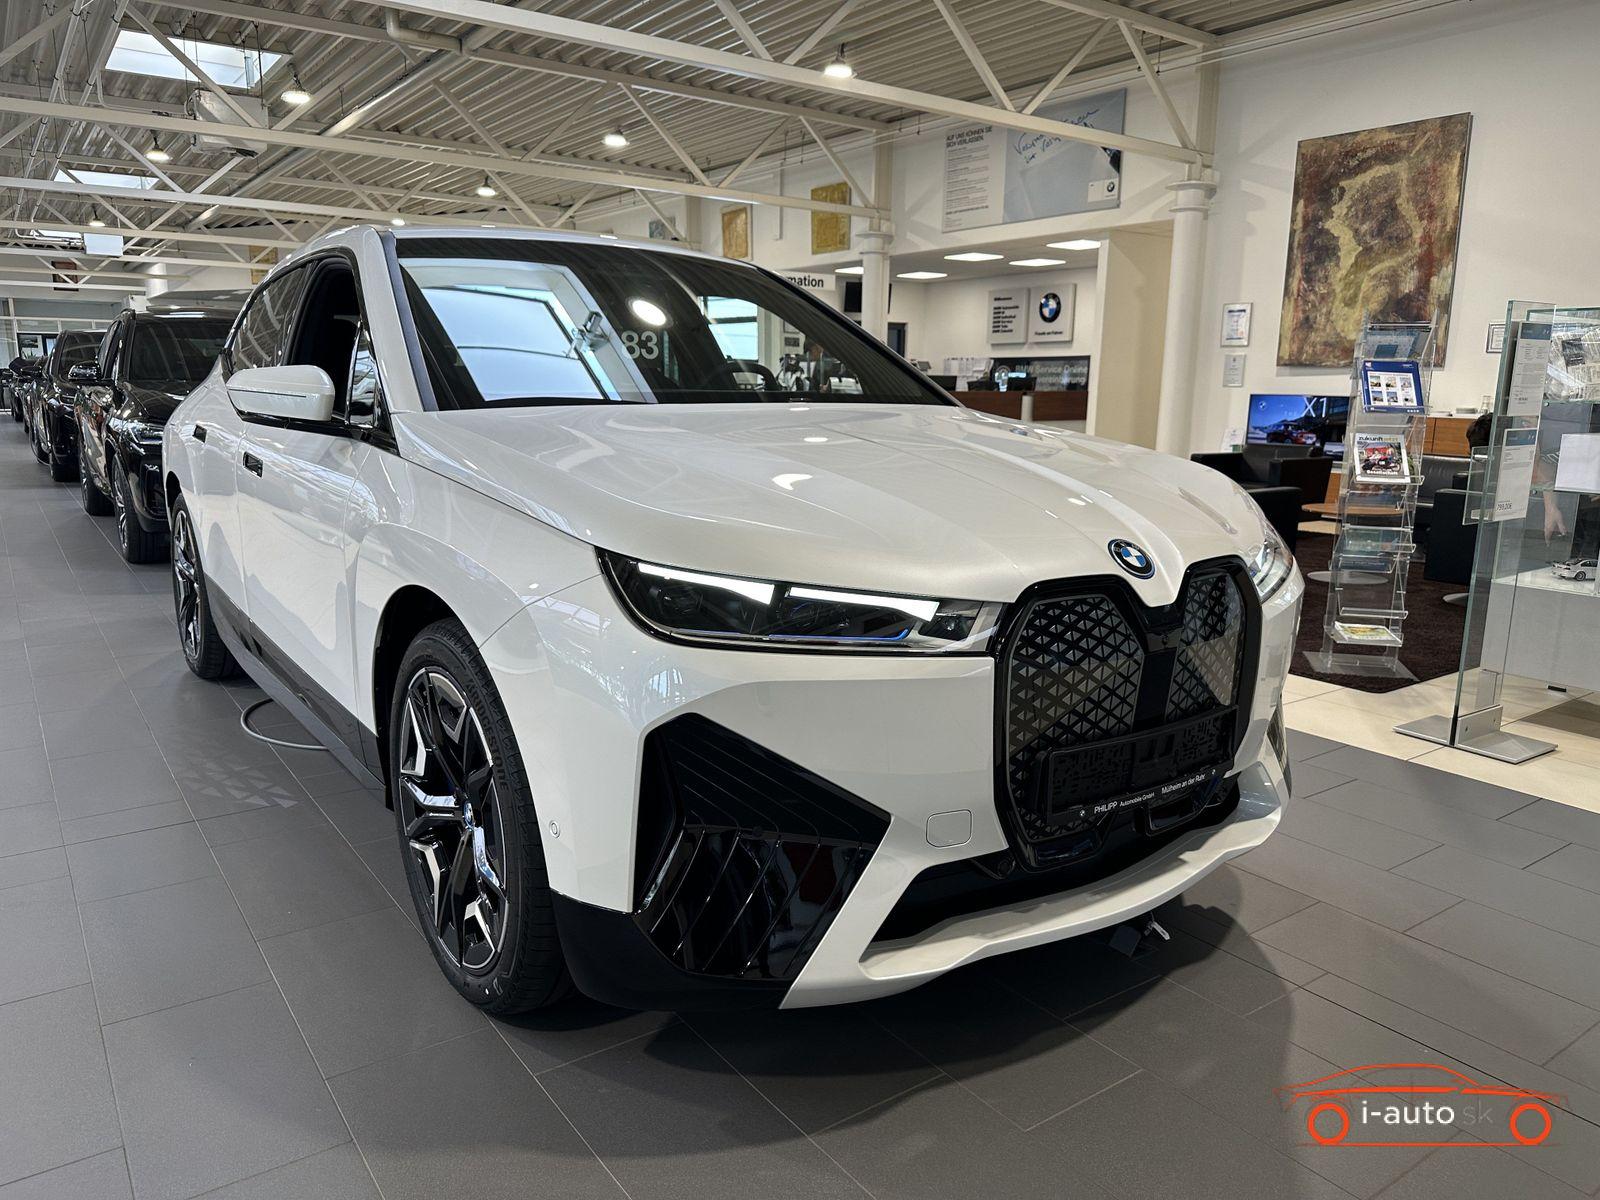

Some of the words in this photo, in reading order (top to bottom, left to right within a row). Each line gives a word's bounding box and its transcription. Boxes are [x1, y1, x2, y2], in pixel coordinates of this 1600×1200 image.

[621, 330, 659, 360] 83
[1300, 397, 1327, 418] X1
[1094, 801, 1118, 814] PHILIPP
